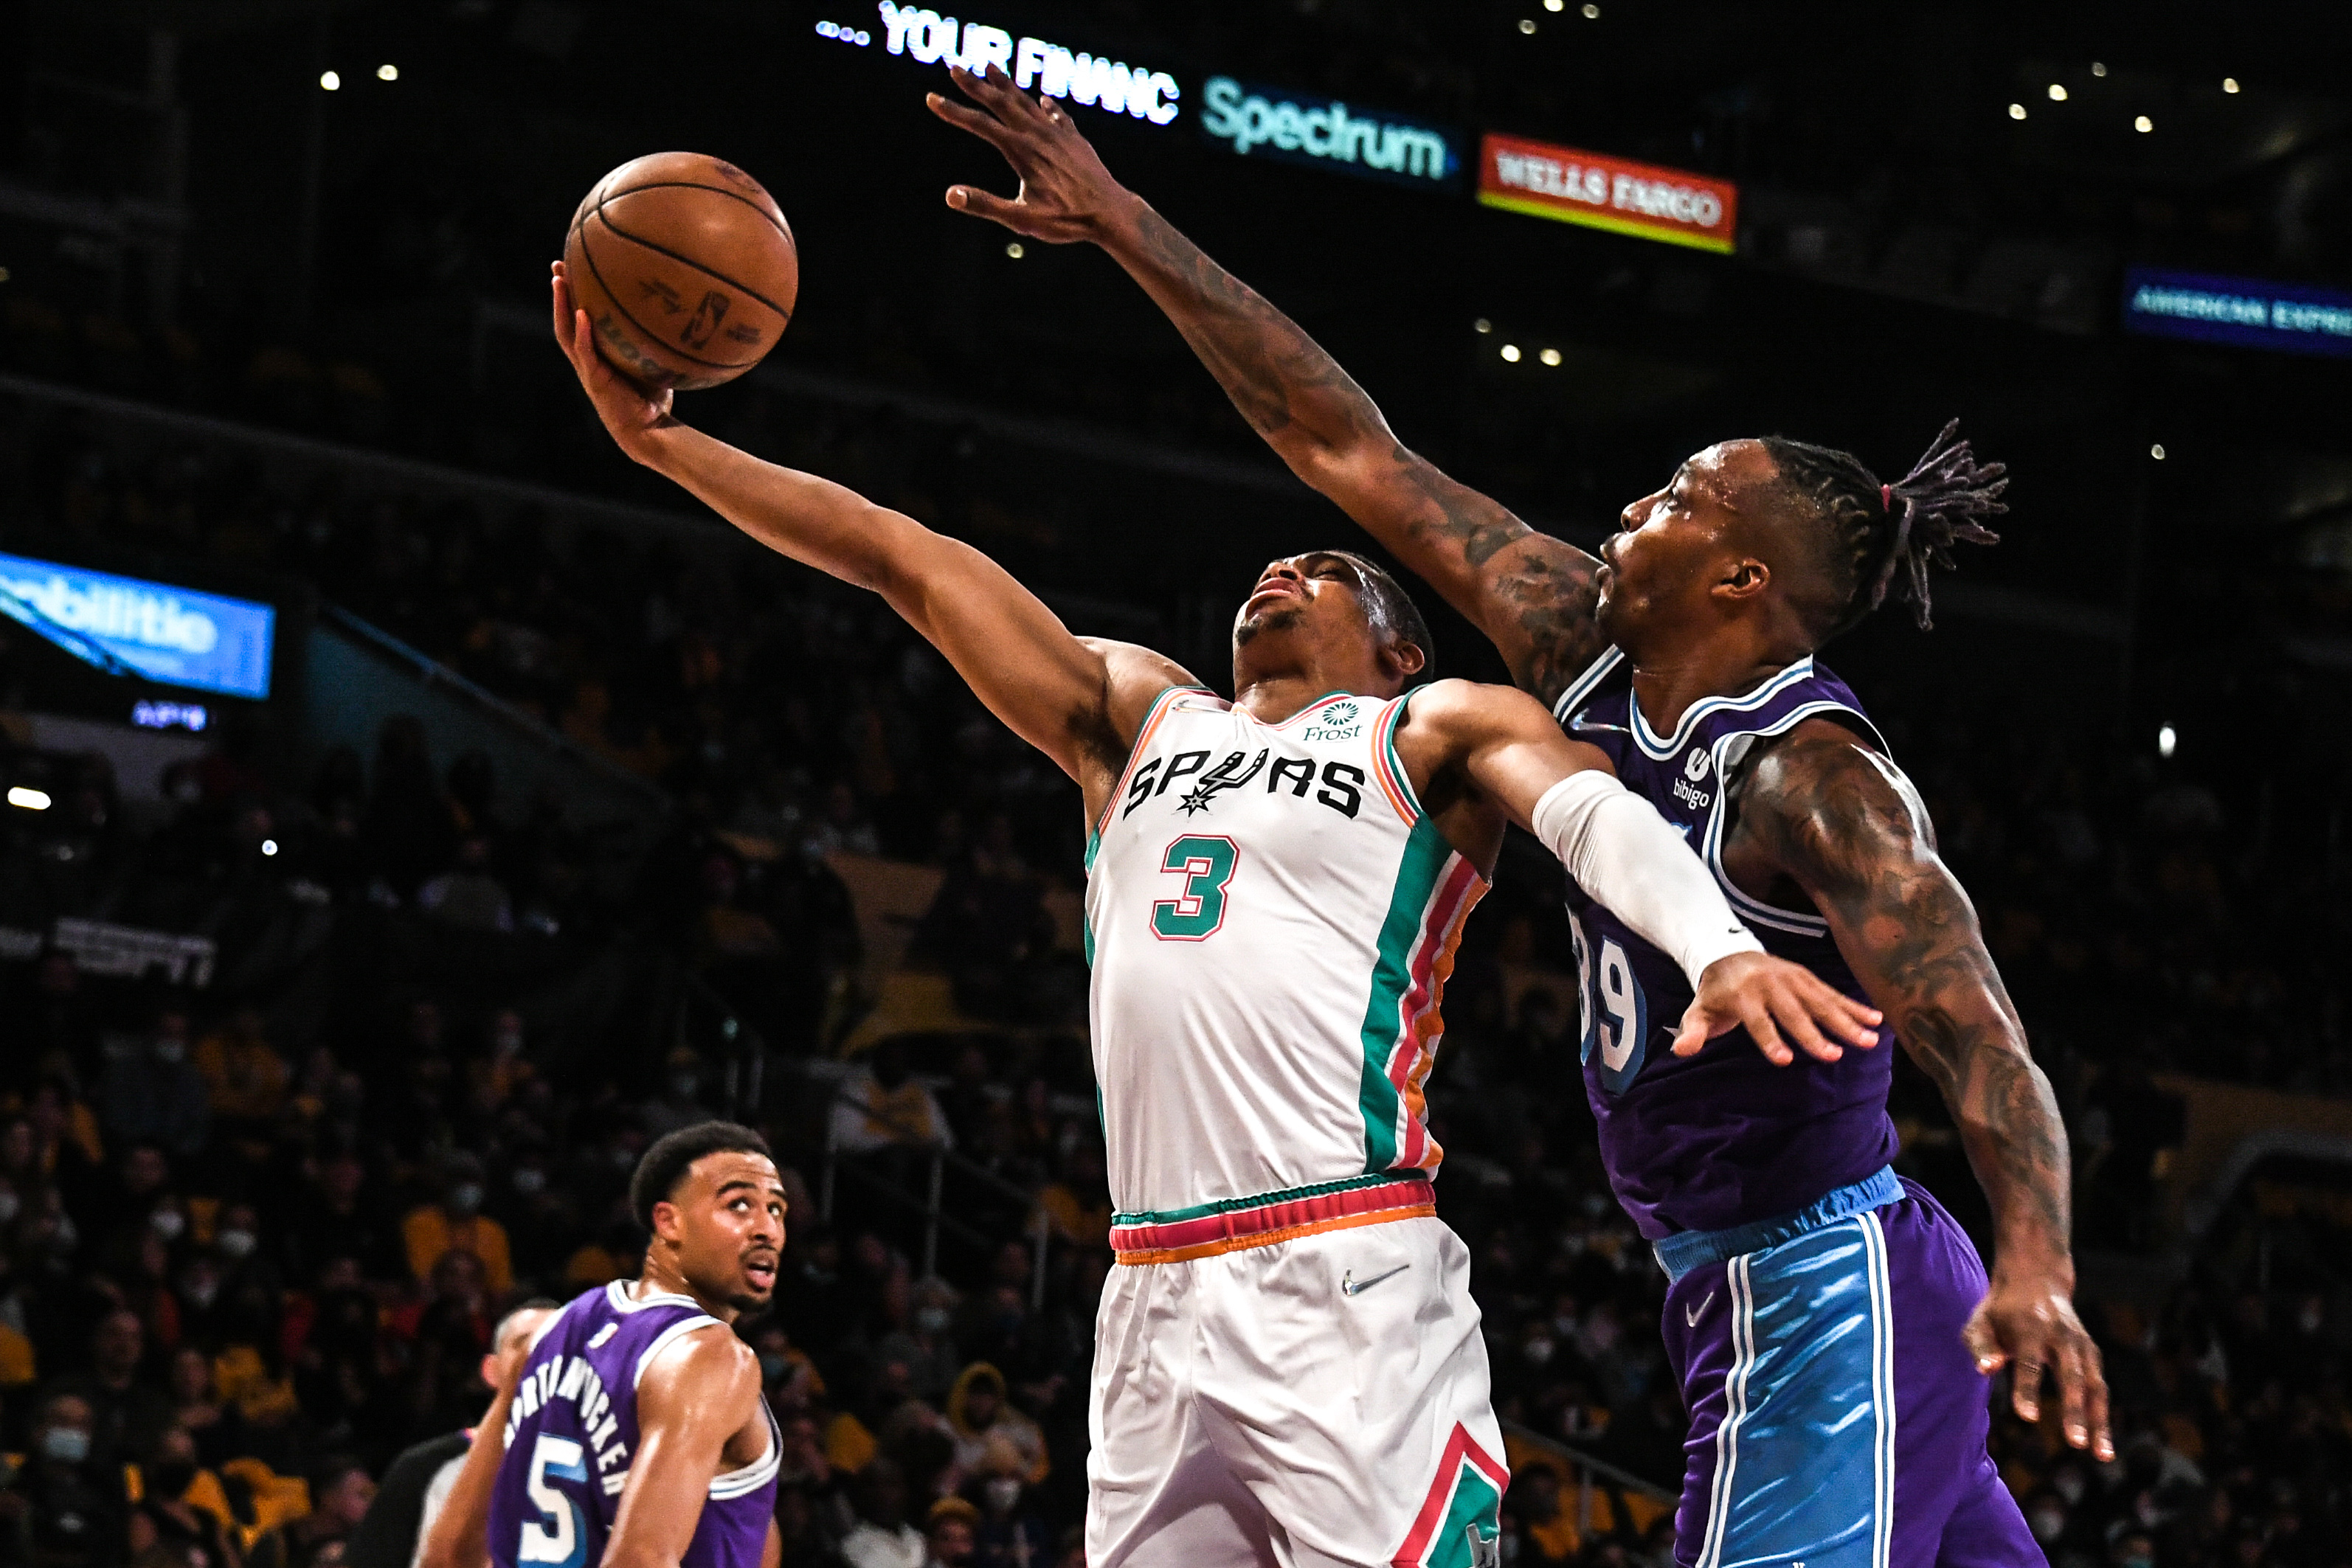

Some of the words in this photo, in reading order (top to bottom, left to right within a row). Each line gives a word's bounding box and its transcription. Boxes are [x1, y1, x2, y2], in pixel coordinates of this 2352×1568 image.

[878, 0, 1014, 78] YOUR
[1201, 75, 1448, 181] Spectrum
[1495, 150, 1609, 206] WELLS
[1611, 172, 1723, 227] FARGO
[1302, 723, 1363, 742] Frost
[1123, 748, 1366, 821] SPURS
[1673, 777, 1710, 811] bibigo
[1149, 833, 1240, 942] 3
[519, 1432, 587, 1567] 5
